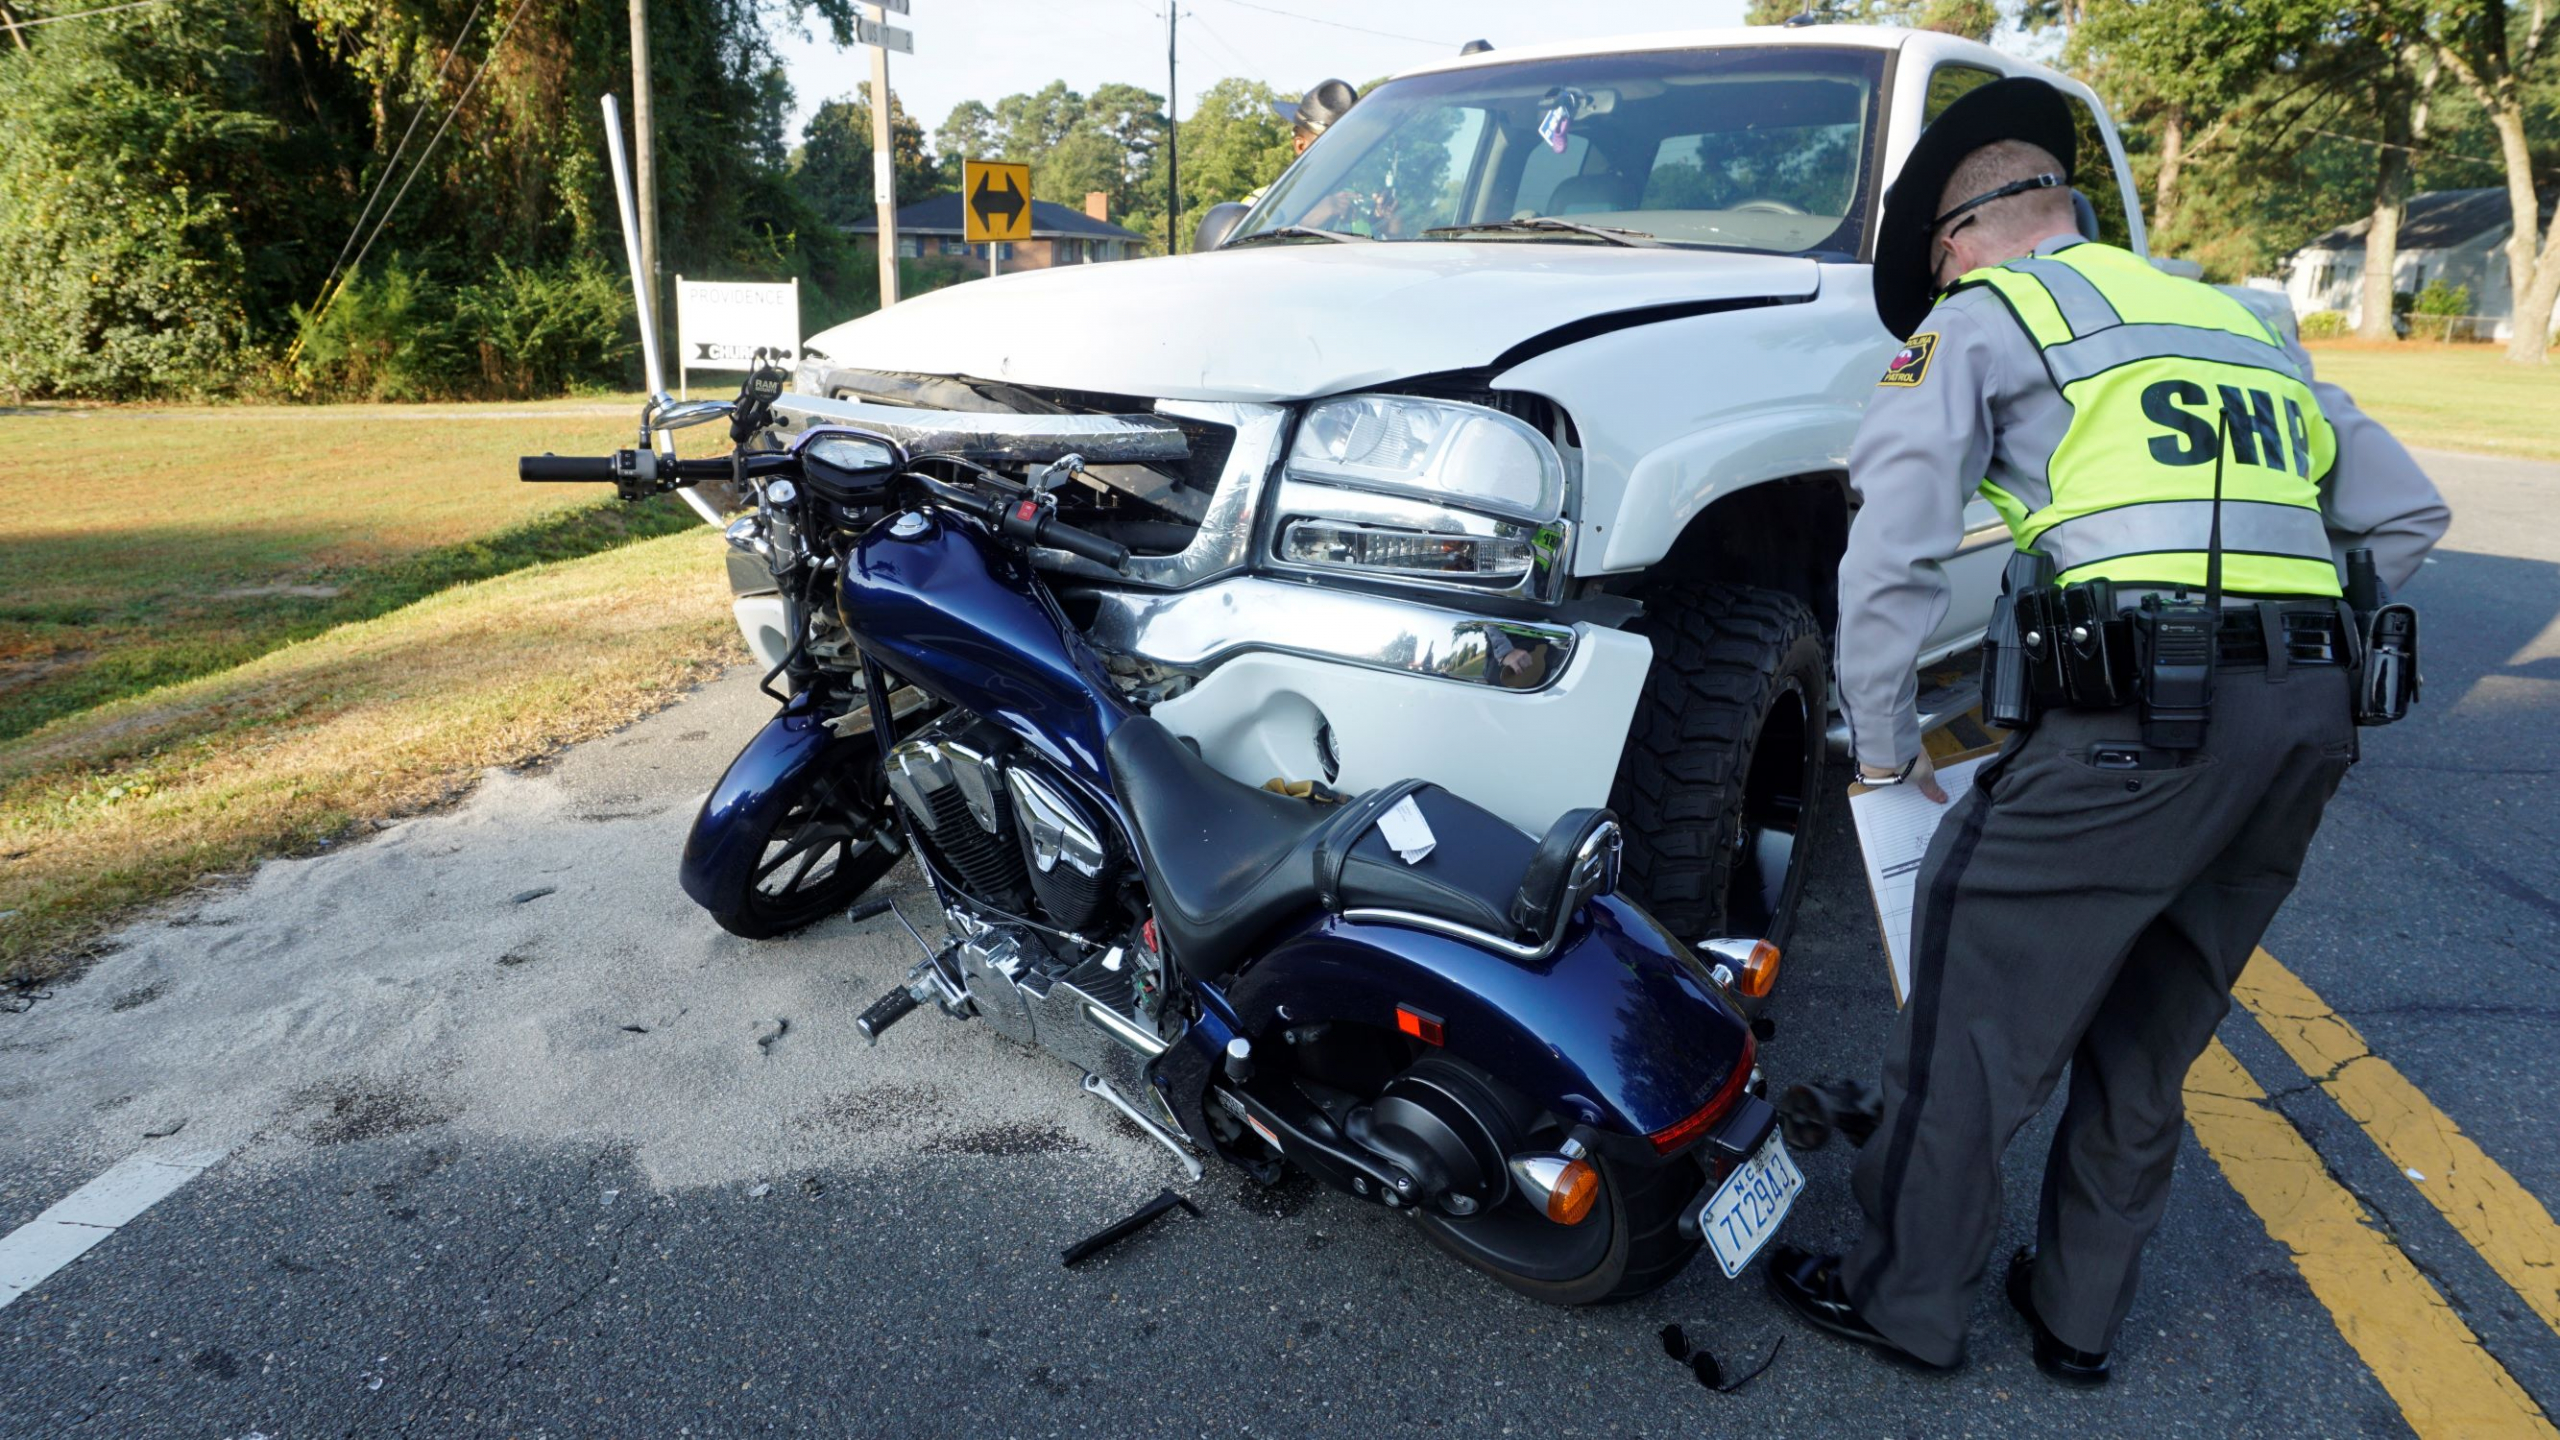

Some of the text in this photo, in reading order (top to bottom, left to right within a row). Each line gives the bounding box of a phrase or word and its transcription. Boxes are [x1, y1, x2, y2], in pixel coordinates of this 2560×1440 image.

[867, 23, 877, 42] US
[690, 288, 784, 305] PROVIDENCE
[709, 344, 770, 360] CHUR
[755, 379, 777, 390] RAM
[1884, 373, 1915, 382] PATROL
[2140, 379, 2310, 483] SHP
[1694, 1060, 1733, 1100] HONDA
